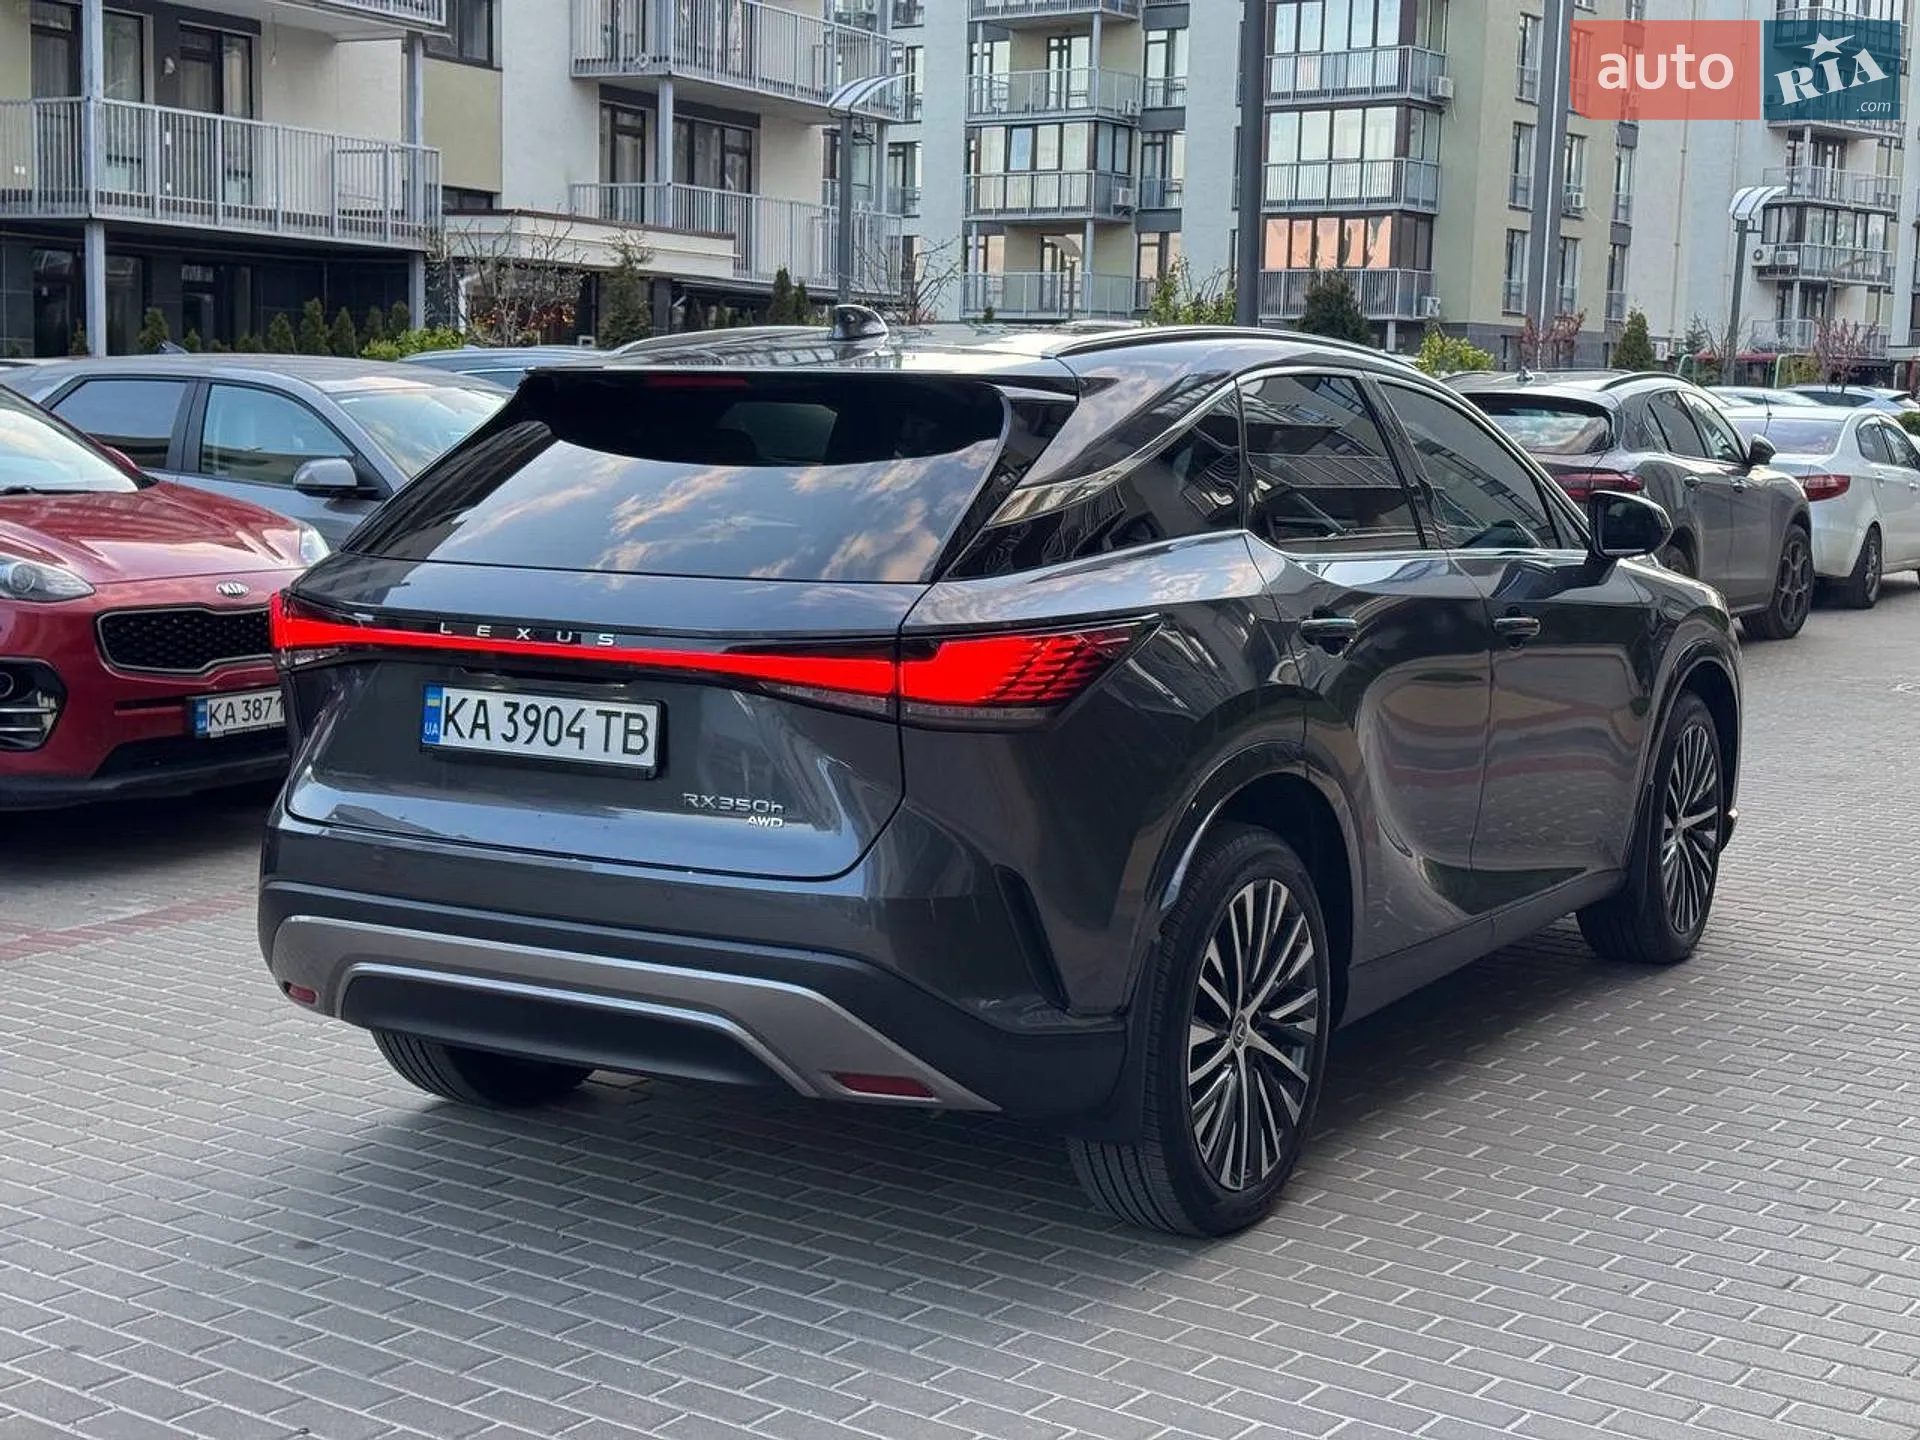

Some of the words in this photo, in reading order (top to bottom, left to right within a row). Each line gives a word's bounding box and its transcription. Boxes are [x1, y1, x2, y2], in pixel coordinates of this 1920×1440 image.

[439, 622, 614, 646] LEXUS
[209, 702, 236, 727] KA
[442, 696, 491, 741] KA
[501, 701, 586, 750] 3904
[595, 709, 650, 755] TB
[424, 722, 439, 736] UA
[747, 815, 784, 828] AWD
